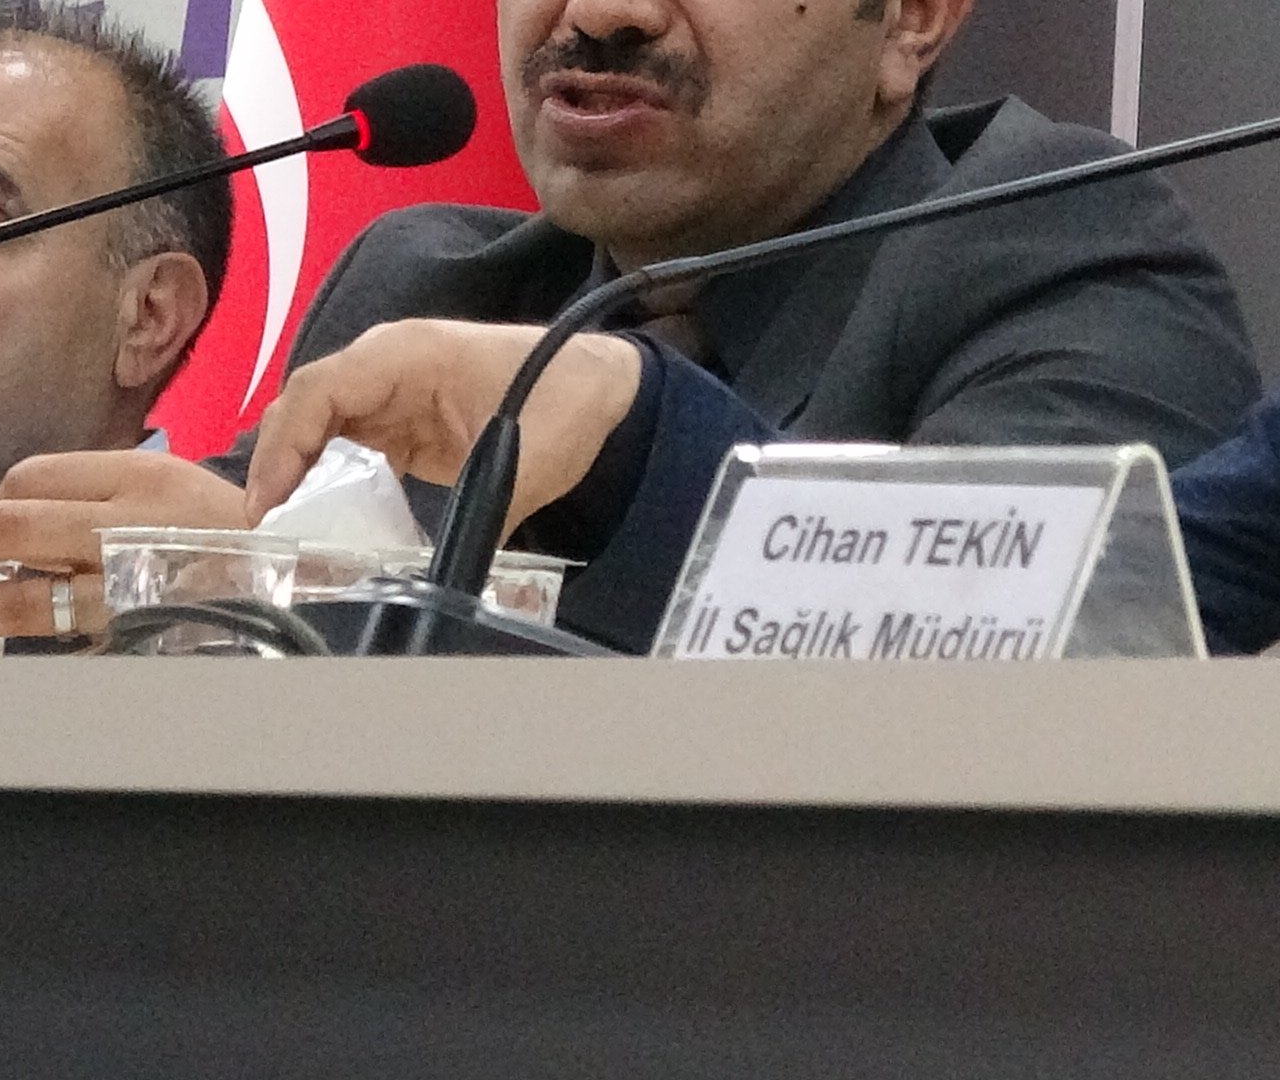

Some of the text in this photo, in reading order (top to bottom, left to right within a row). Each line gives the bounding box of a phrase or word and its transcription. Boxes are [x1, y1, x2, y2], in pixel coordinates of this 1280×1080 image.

[762, 507, 1045, 569] Cihan TEKİN
[686, 593, 1045, 659] İl Sağlık Müdürü
